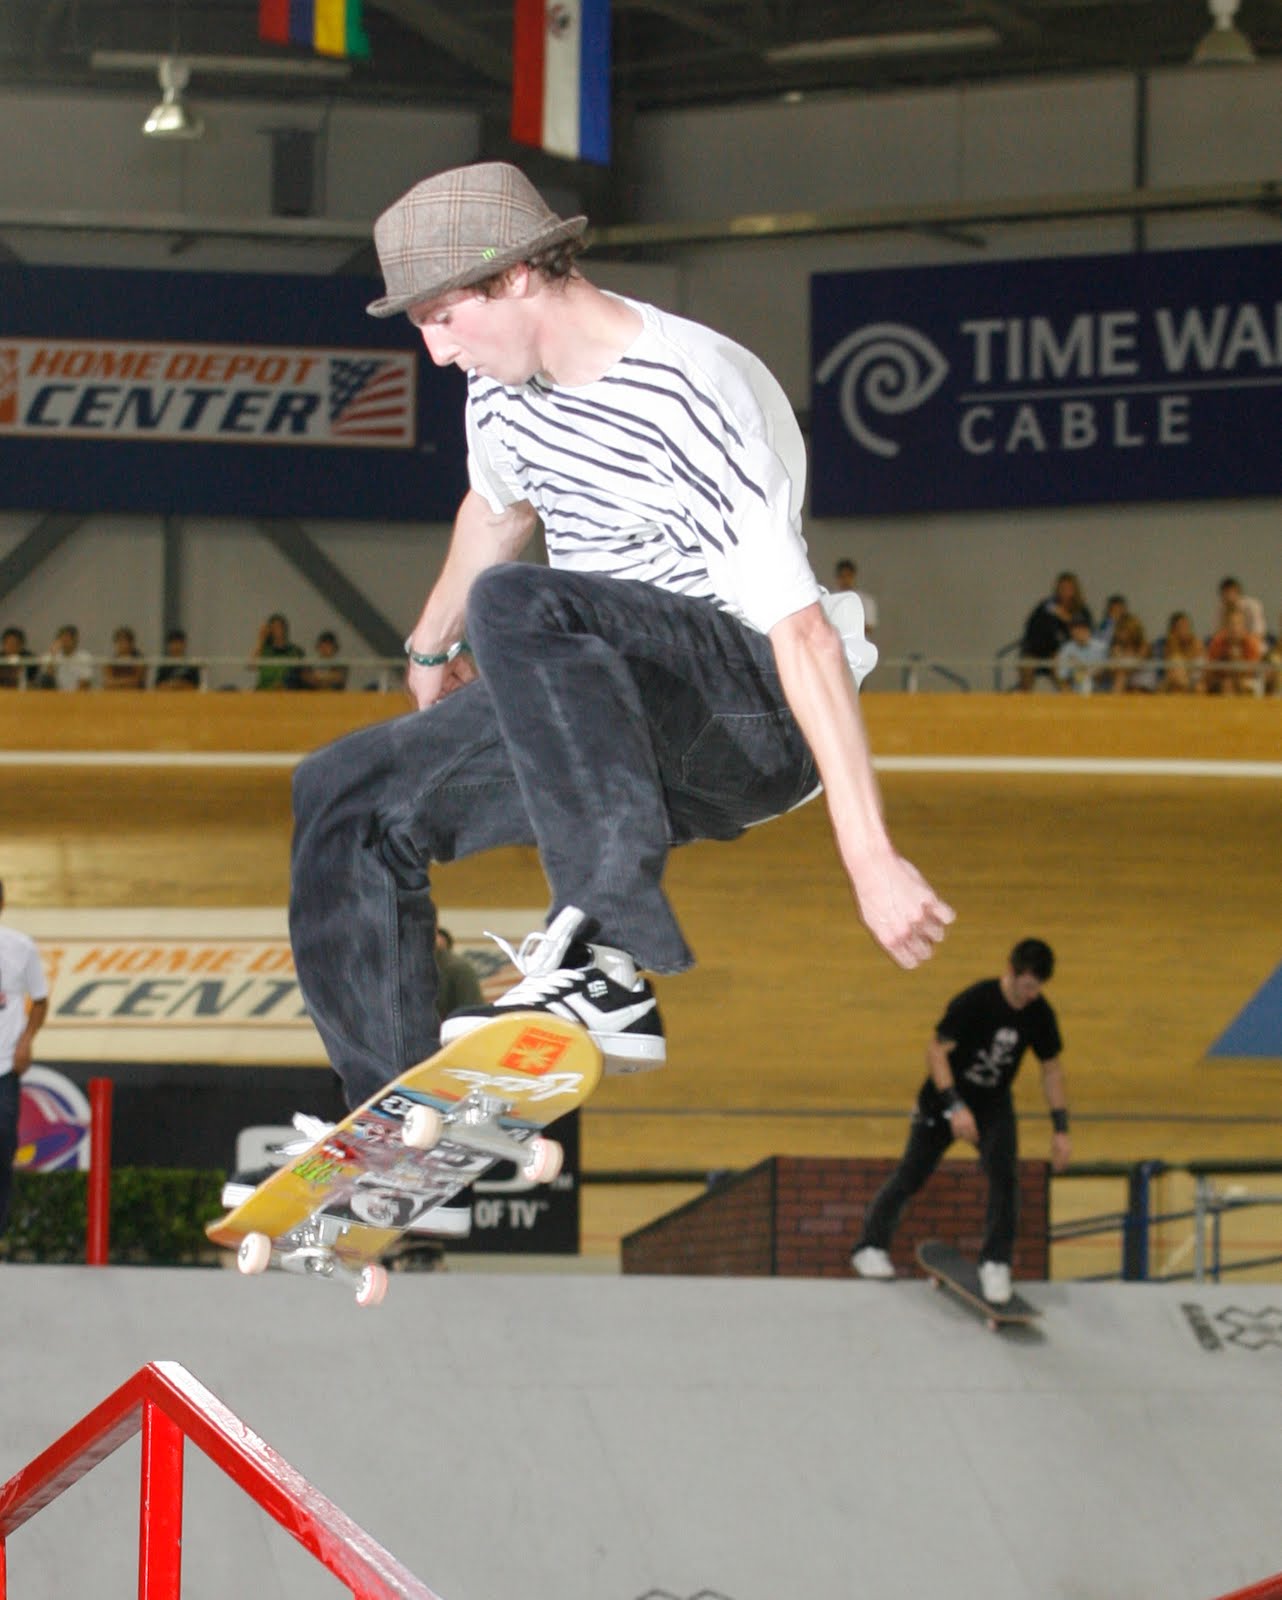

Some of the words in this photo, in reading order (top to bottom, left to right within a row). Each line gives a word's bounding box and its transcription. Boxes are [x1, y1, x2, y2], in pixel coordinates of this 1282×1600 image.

[960, 310, 1140, 383] TIME
[27, 348, 160, 380] HOME
[164, 352, 320, 386] DEPOT
[25, 384, 322, 435] CENTER
[958, 398, 1191, 455] CABLE
[72, 946, 239, 973] HOME
[55, 978, 309, 1017] CENT
[474, 1199, 503, 1229] OF
